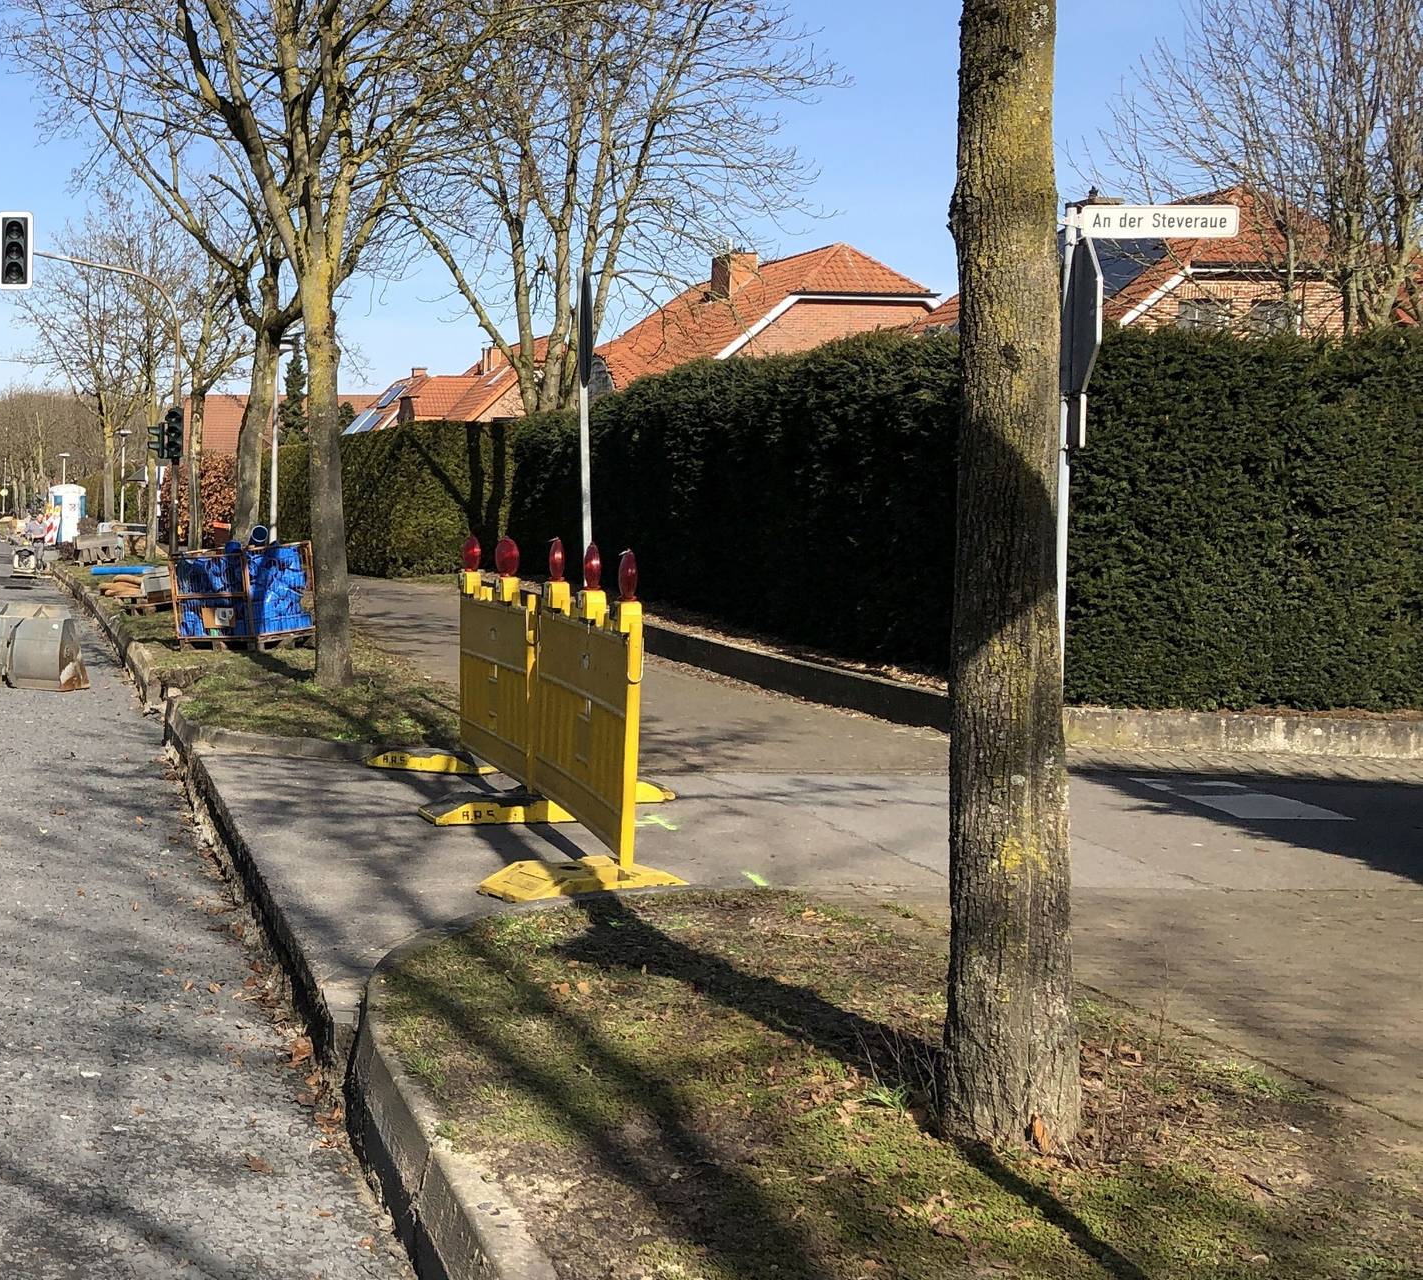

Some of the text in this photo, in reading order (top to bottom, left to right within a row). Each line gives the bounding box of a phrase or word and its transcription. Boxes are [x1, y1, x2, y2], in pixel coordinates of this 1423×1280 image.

[1092, 212, 1228, 229] An der Steveraue
